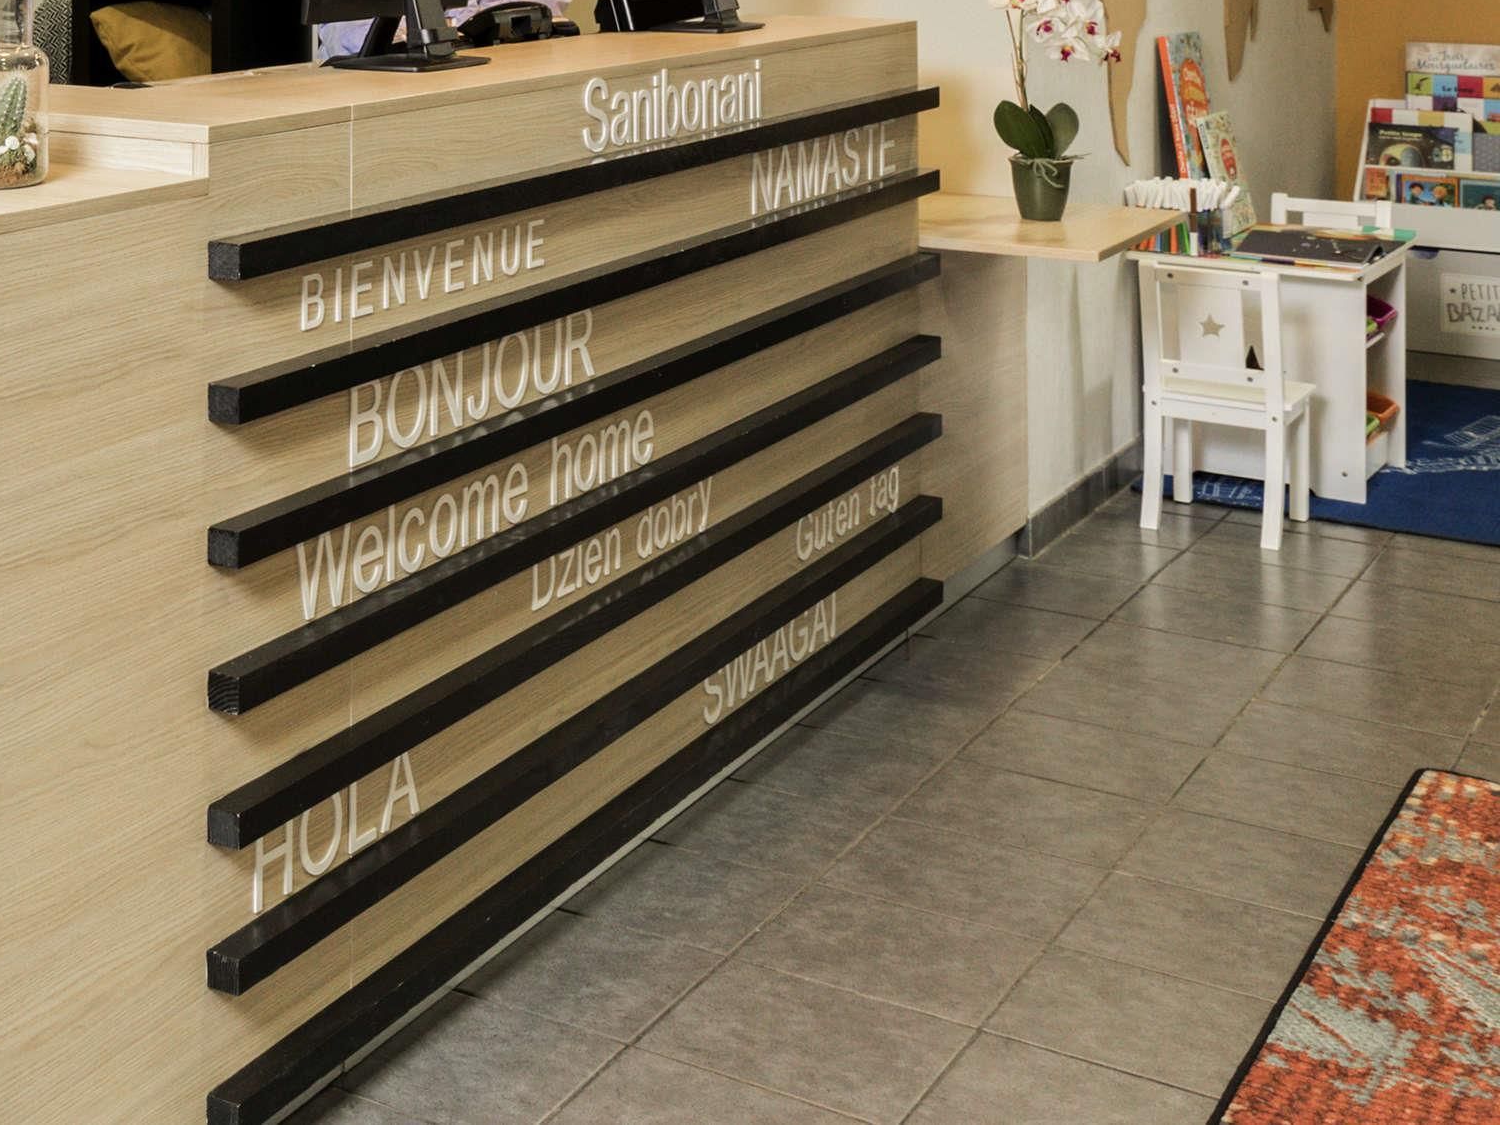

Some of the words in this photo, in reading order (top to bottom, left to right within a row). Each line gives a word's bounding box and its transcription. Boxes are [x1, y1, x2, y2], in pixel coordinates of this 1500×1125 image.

[583, 59, 761, 152] Sanibonani
[751, 123, 897, 215] NAMASTE
[301, 219, 546, 332] BIENVENUE
[349, 309, 596, 468] BONJOUR
[297, 462, 529, 621] Welcome
[550, 410, 654, 507] home
[636, 476, 713, 559] dobry
[796, 491, 860, 561] Guten
[869, 465, 900, 516] tag
[252, 751, 421, 915] HOLA
